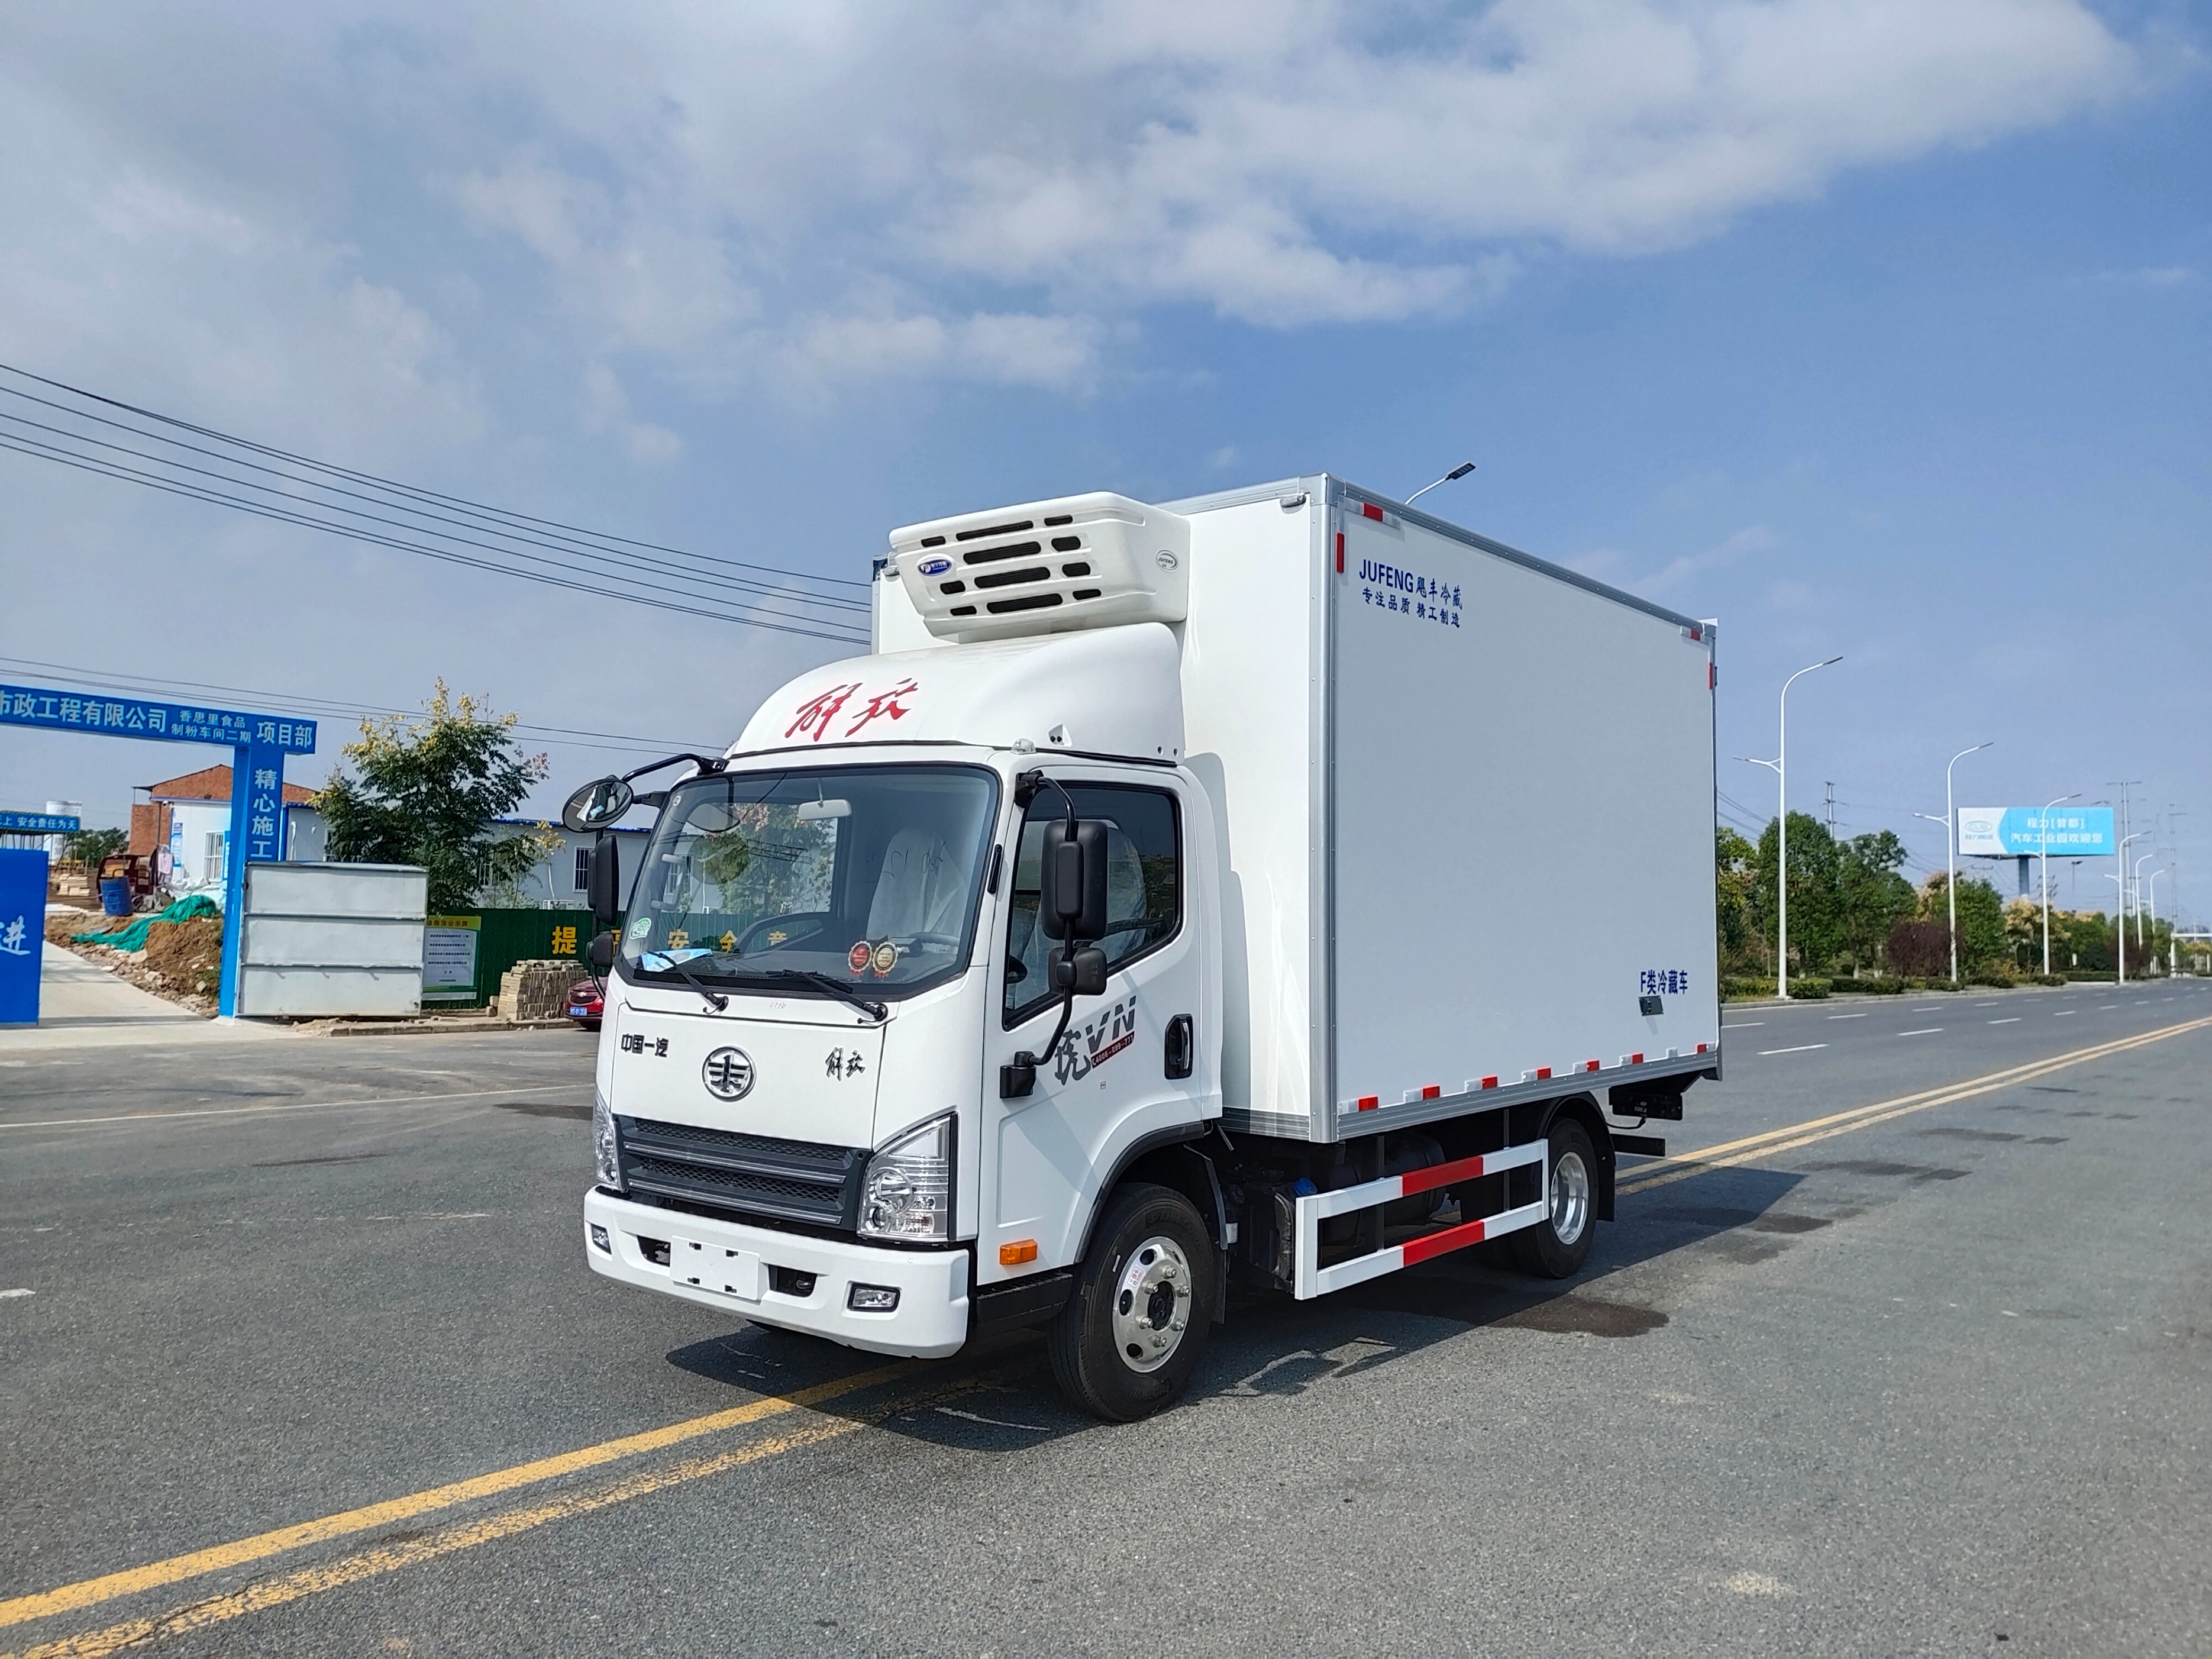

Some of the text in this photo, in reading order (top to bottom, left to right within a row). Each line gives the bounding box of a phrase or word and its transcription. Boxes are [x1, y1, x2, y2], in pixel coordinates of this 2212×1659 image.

[1359, 559, 1414, 593] JUFENG
[1362, 586, 1461, 628] 专注品质 精工制造
[179, 709, 246, 729] 香思里食品
[171, 723, 252, 744] 制粉车间二期
[256, 721, 314, 748] 项目部
[17, 816, 77, 830] 安全责任为天
[250, 768, 278, 858] 精心施工
[2010, 832, 2104, 844] 汽车工业园欢迎您
[551, 925, 578, 955] 提
[1640, 969, 1688, 995] F类冷藏车
[621, 1033, 670, 1058] 中国一汽
